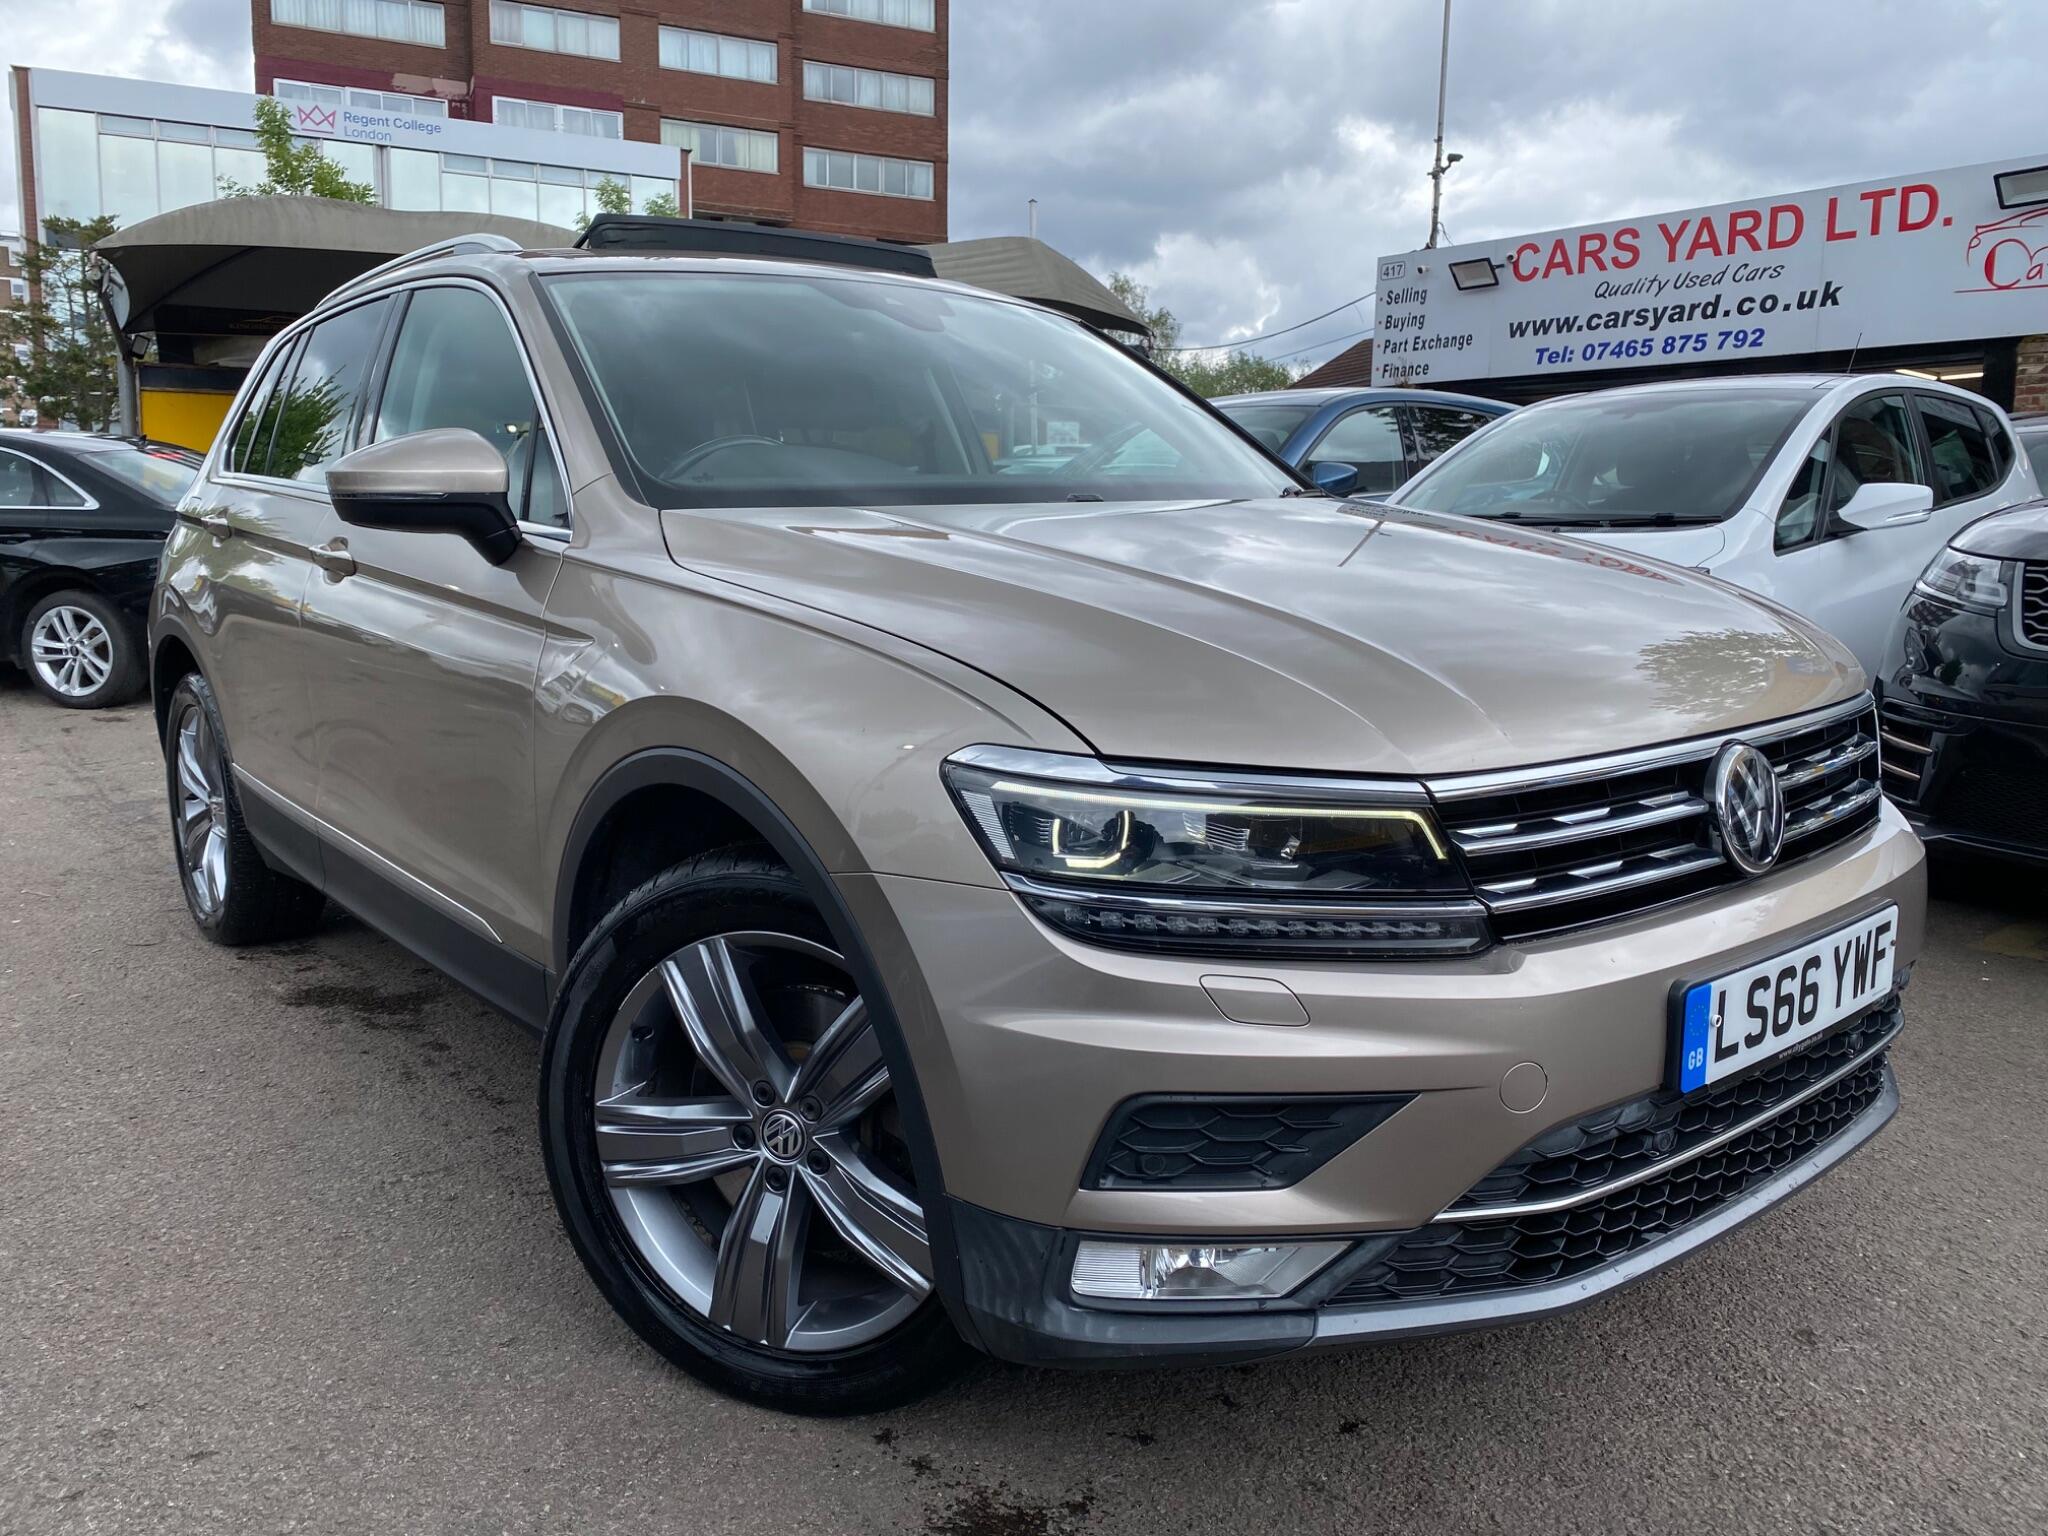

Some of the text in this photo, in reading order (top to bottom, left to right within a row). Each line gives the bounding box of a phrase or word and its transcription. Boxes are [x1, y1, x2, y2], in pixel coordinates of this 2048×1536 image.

[343, 111, 442, 134] Regent College
[344, 126, 392, 142] London
[1512, 183, 1953, 283] CARS YARD LTD.
[1383, 264, 1404, 278] 417
[1594, 262, 1785, 300] Quality Used Cars
[1386, 287, 1428, 305] Selling
[1508, 280, 1844, 339] www.carsyard.co.uk
[1384, 312, 1426, 332] Buying
[1383, 333, 1473, 355] Part Exchange
[1535, 327, 1765, 365] Tel: 07465 875 792
[1381, 363, 1430, 379] Finance
[1714, 920, 1892, 1063] LS66 YWF
[1688, 1047, 1704, 1071] GB
